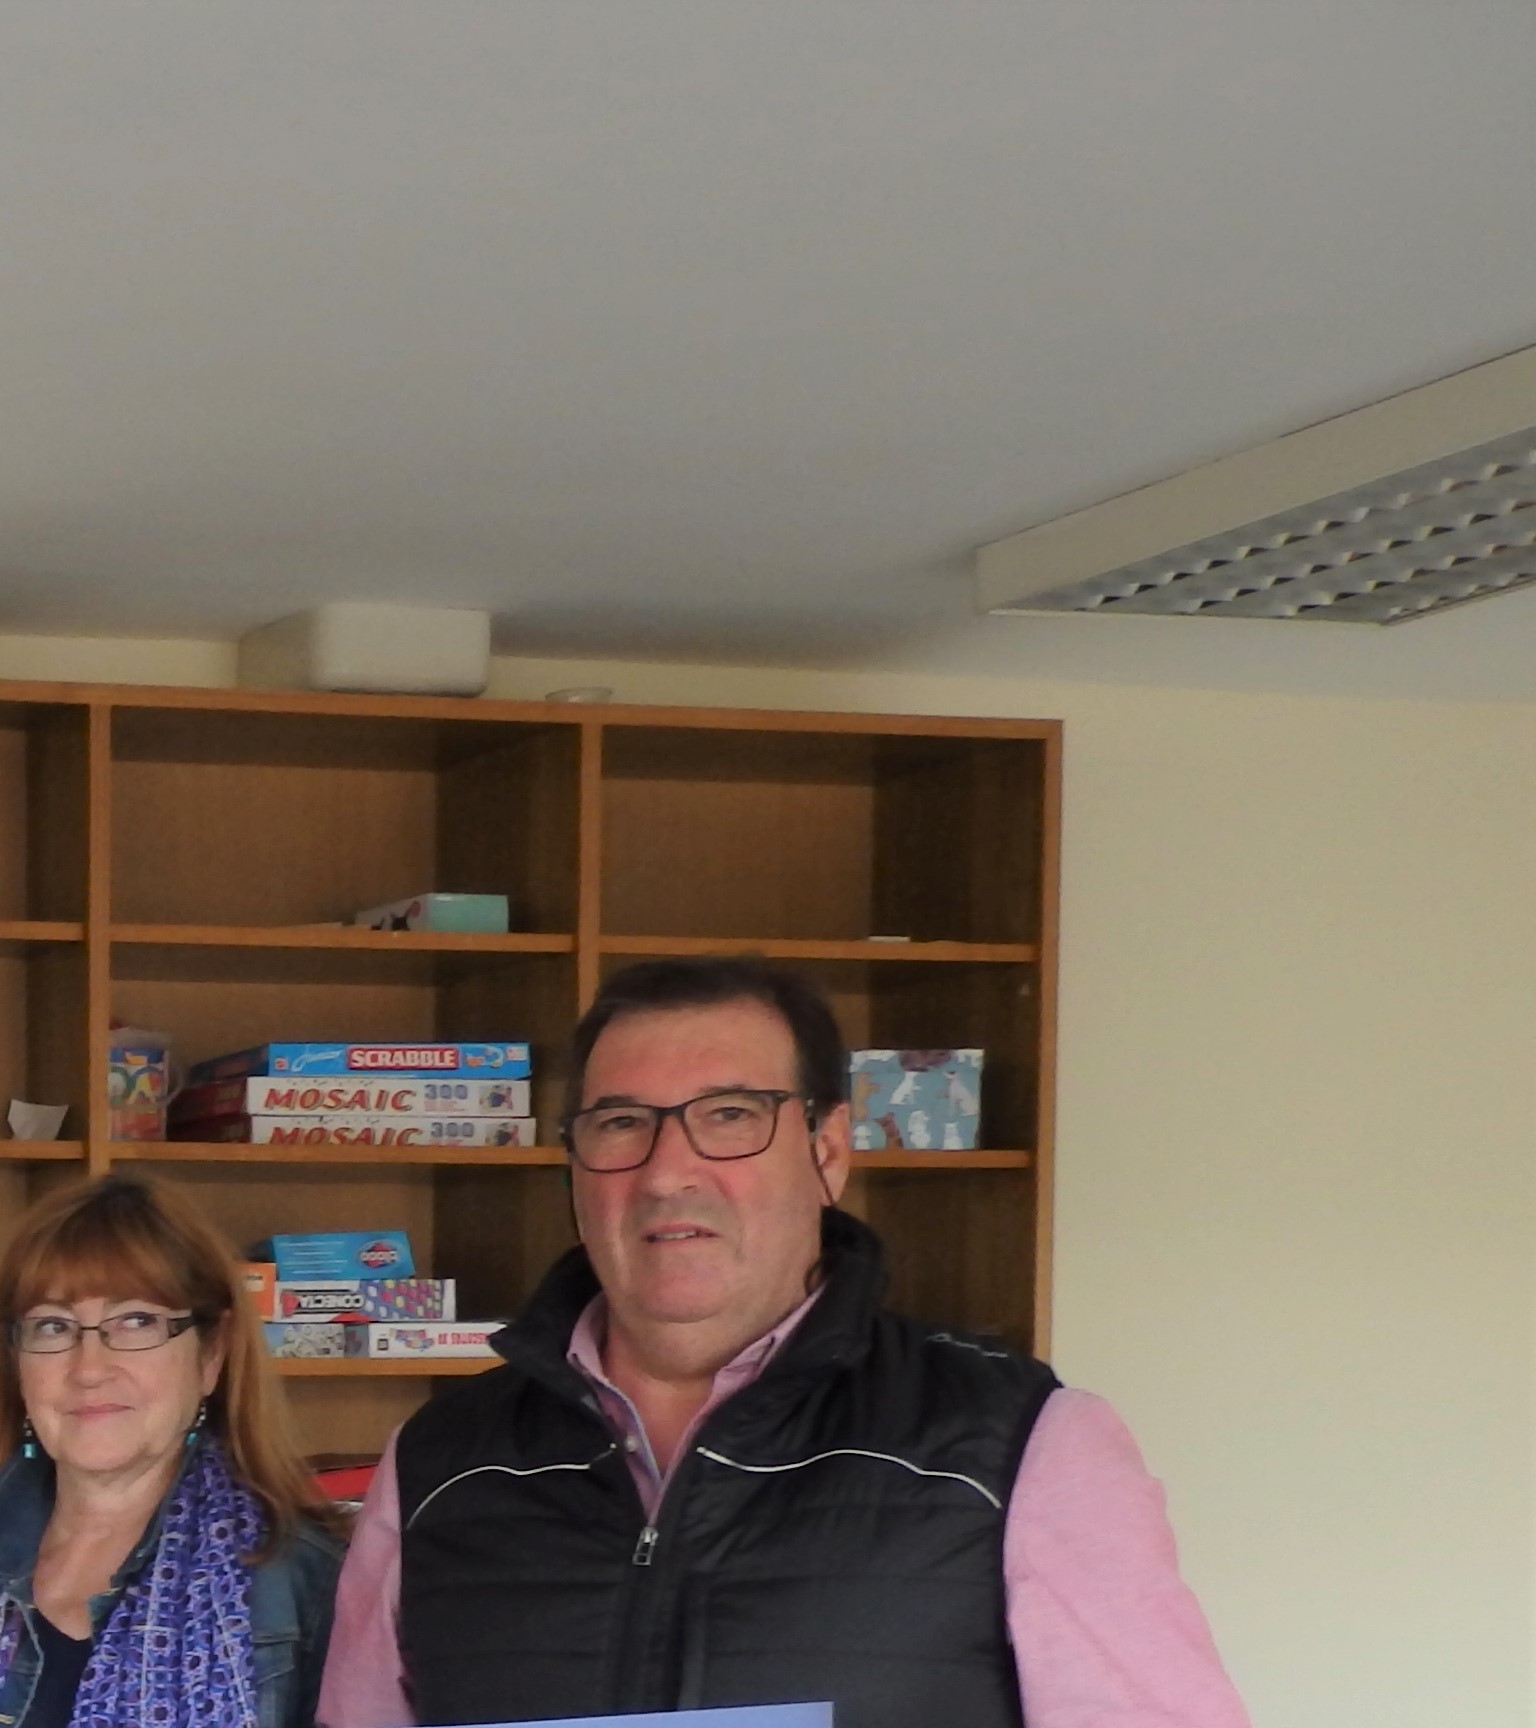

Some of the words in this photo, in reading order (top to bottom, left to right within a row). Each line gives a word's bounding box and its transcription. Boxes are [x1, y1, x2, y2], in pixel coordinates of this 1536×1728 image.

[350, 1049, 457, 1069] SCRABBLE
[263, 1087, 417, 1113] MOSAIC
[424, 1084, 469, 1100] 300
[269, 1126, 423, 1146] MOSAIC
[430, 1121, 475, 1138] 300
